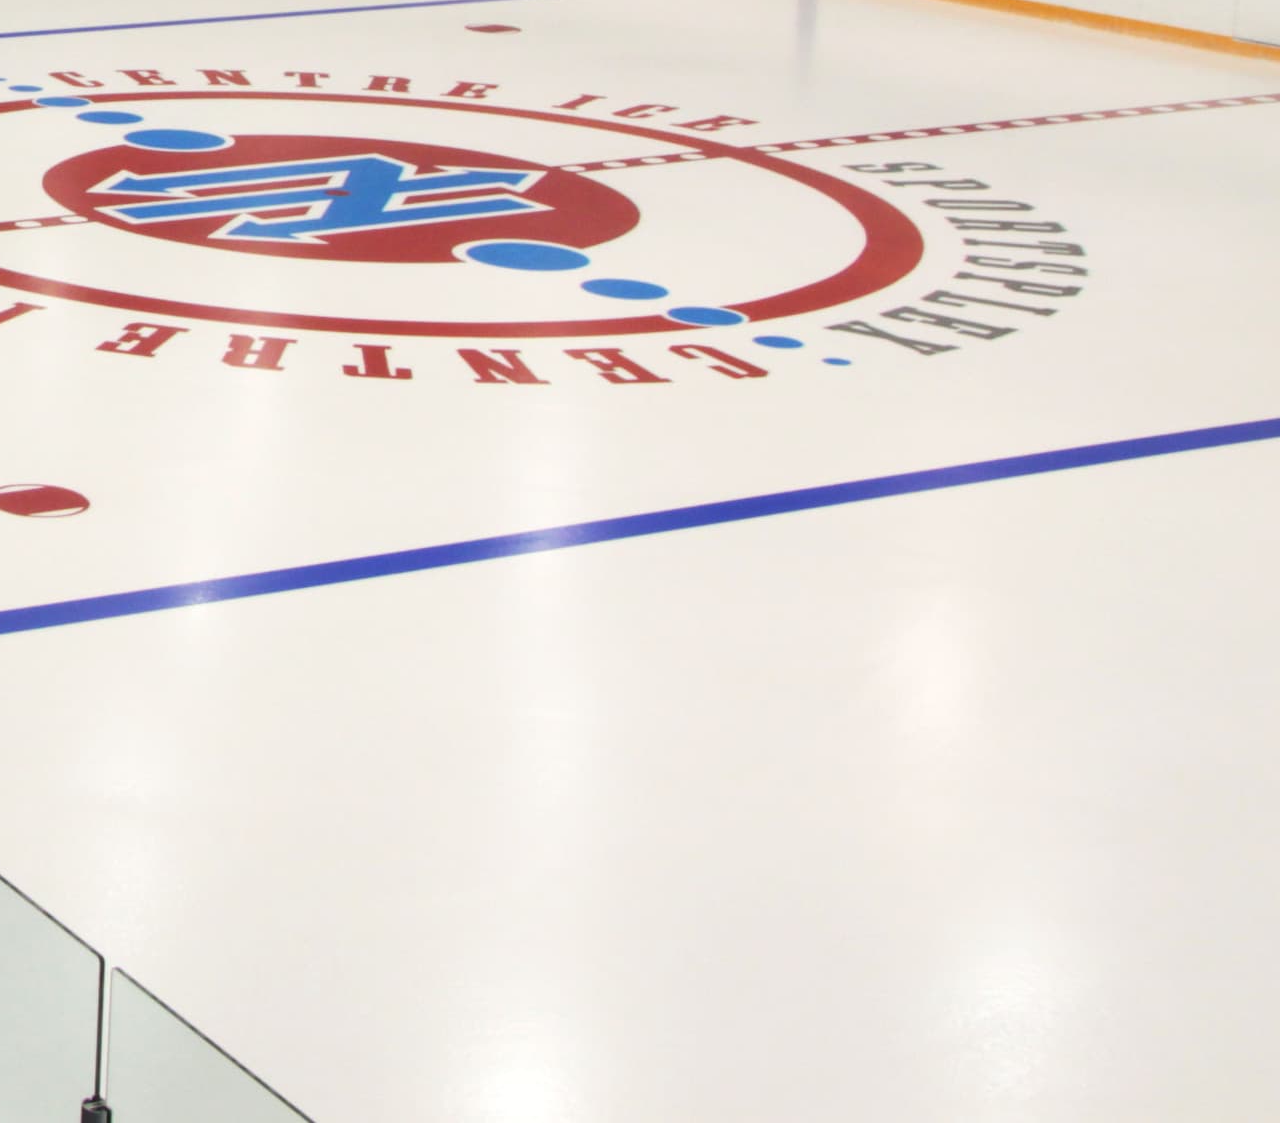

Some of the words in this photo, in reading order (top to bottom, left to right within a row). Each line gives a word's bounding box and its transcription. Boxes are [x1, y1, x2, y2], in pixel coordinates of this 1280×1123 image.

[49, 69, 500, 100] CENTRE
[552, 93, 760, 133] ICE
[842, 161, 1090, 357] SPORTSPLEX
[95, 322, 771, 386] CENTRE
